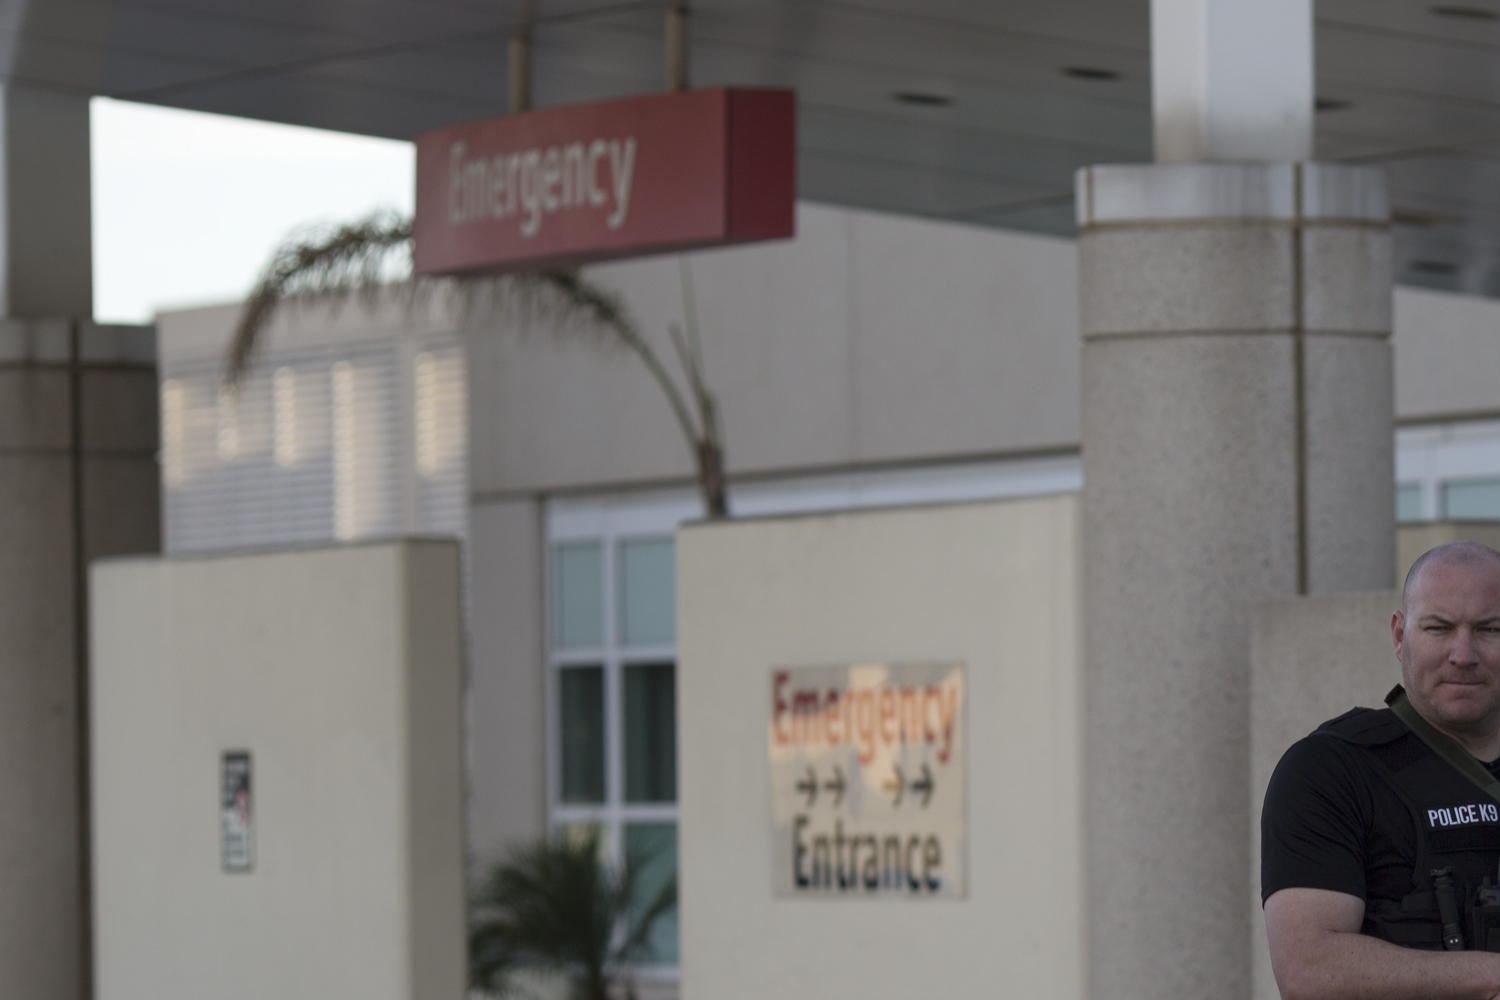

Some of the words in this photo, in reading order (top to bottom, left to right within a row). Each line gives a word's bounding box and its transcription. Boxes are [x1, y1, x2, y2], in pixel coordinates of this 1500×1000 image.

[448, 138, 637, 237] Emergency
[772, 670, 958, 766] Emergency
[793, 813, 942, 891] Entrance
[1428, 804, 1479, 828] POLICE
[1478, 803, 1499, 823] K9
